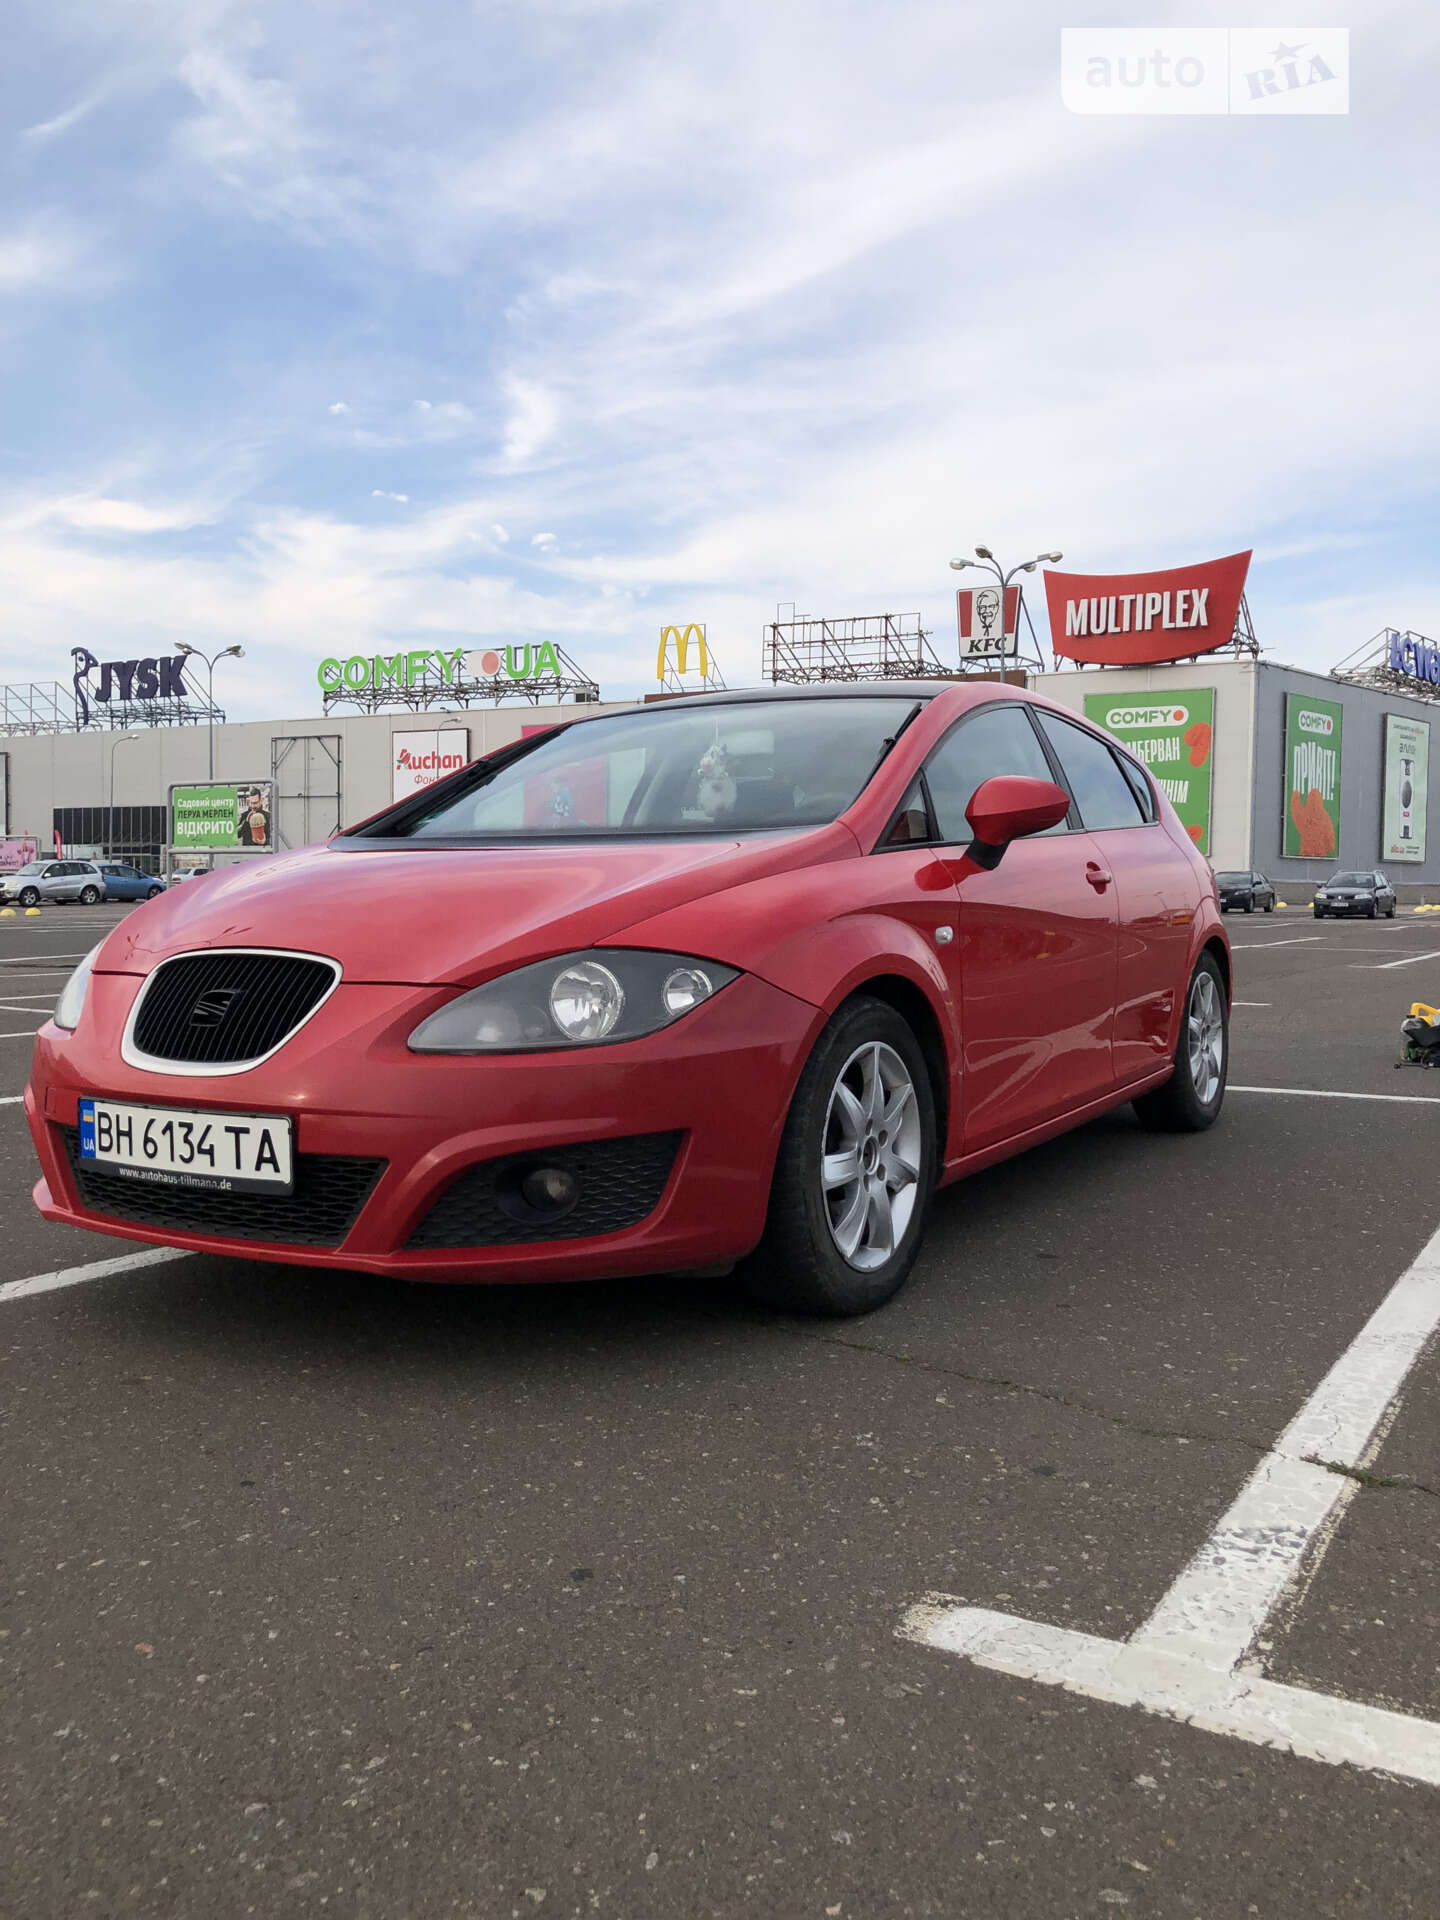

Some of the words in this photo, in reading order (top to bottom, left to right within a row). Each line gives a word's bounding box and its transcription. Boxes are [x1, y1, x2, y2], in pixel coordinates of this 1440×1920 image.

[1065, 588, 1209, 637] MULTIPLEX
[968, 637, 1007, 653] KFC
[318, 648, 462, 691] COMFY
[506, 640, 561, 679] UA
[95, 655, 188, 702] JYSK
[1110, 709, 1172, 725] COMFY
[1300, 714, 1327, 730] COMFY
[396, 748, 463, 770] Auchan
[177, 797, 210, 808] Садовий
[211, 799, 234, 809] центр
[178, 810, 201, 819] ЛЕРУА
[203, 809, 234, 818] МЕРЛЕН
[177, 821, 234, 837] ВІДКРИТО
[83, 1138, 95, 1151] UA
[97, 1112, 133, 1156] BH
[143, 1119, 215, 1167] 6134
[224, 1126, 280, 1173] TA
[119, 1166, 232, 1190] www.autohaus-tillmann.de
